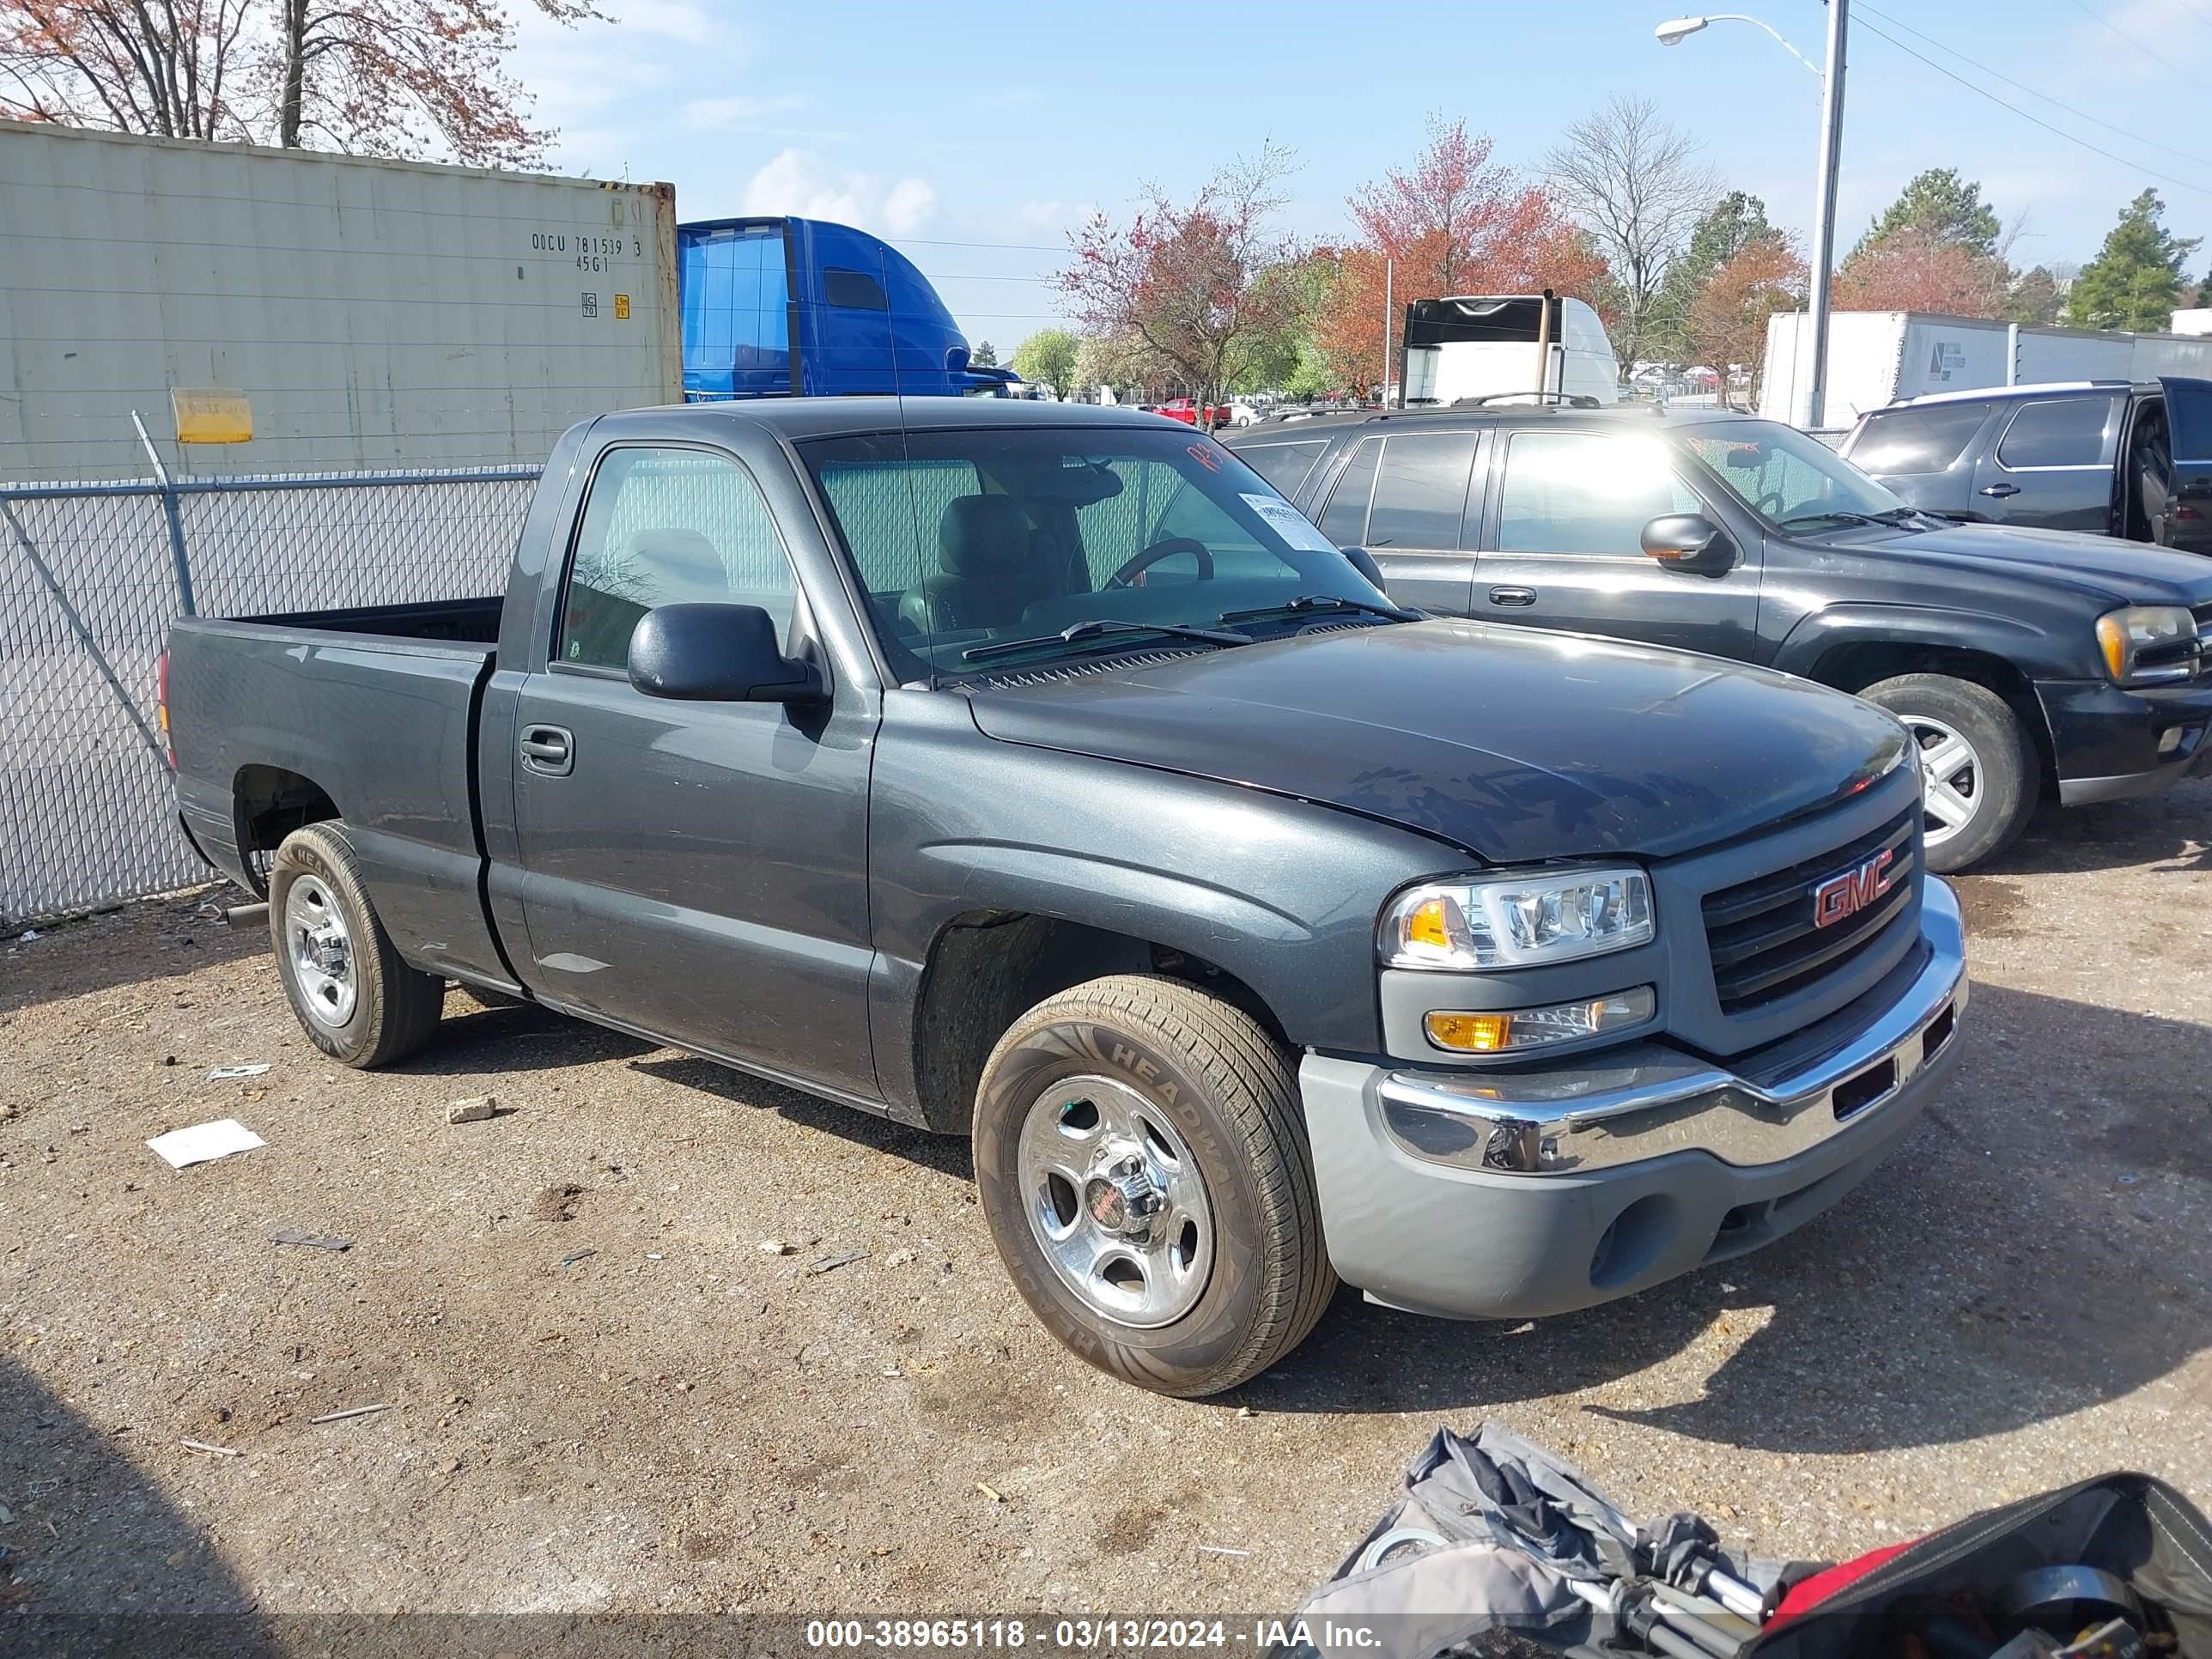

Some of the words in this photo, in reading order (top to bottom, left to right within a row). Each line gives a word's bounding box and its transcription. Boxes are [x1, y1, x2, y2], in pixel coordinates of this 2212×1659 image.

[575, 236, 622, 255] 781539
[634, 241, 641, 257] 3
[576, 255, 608, 272] 45G1
[584, 307, 594, 315] 70
[1814, 848, 1893, 928] GMC
